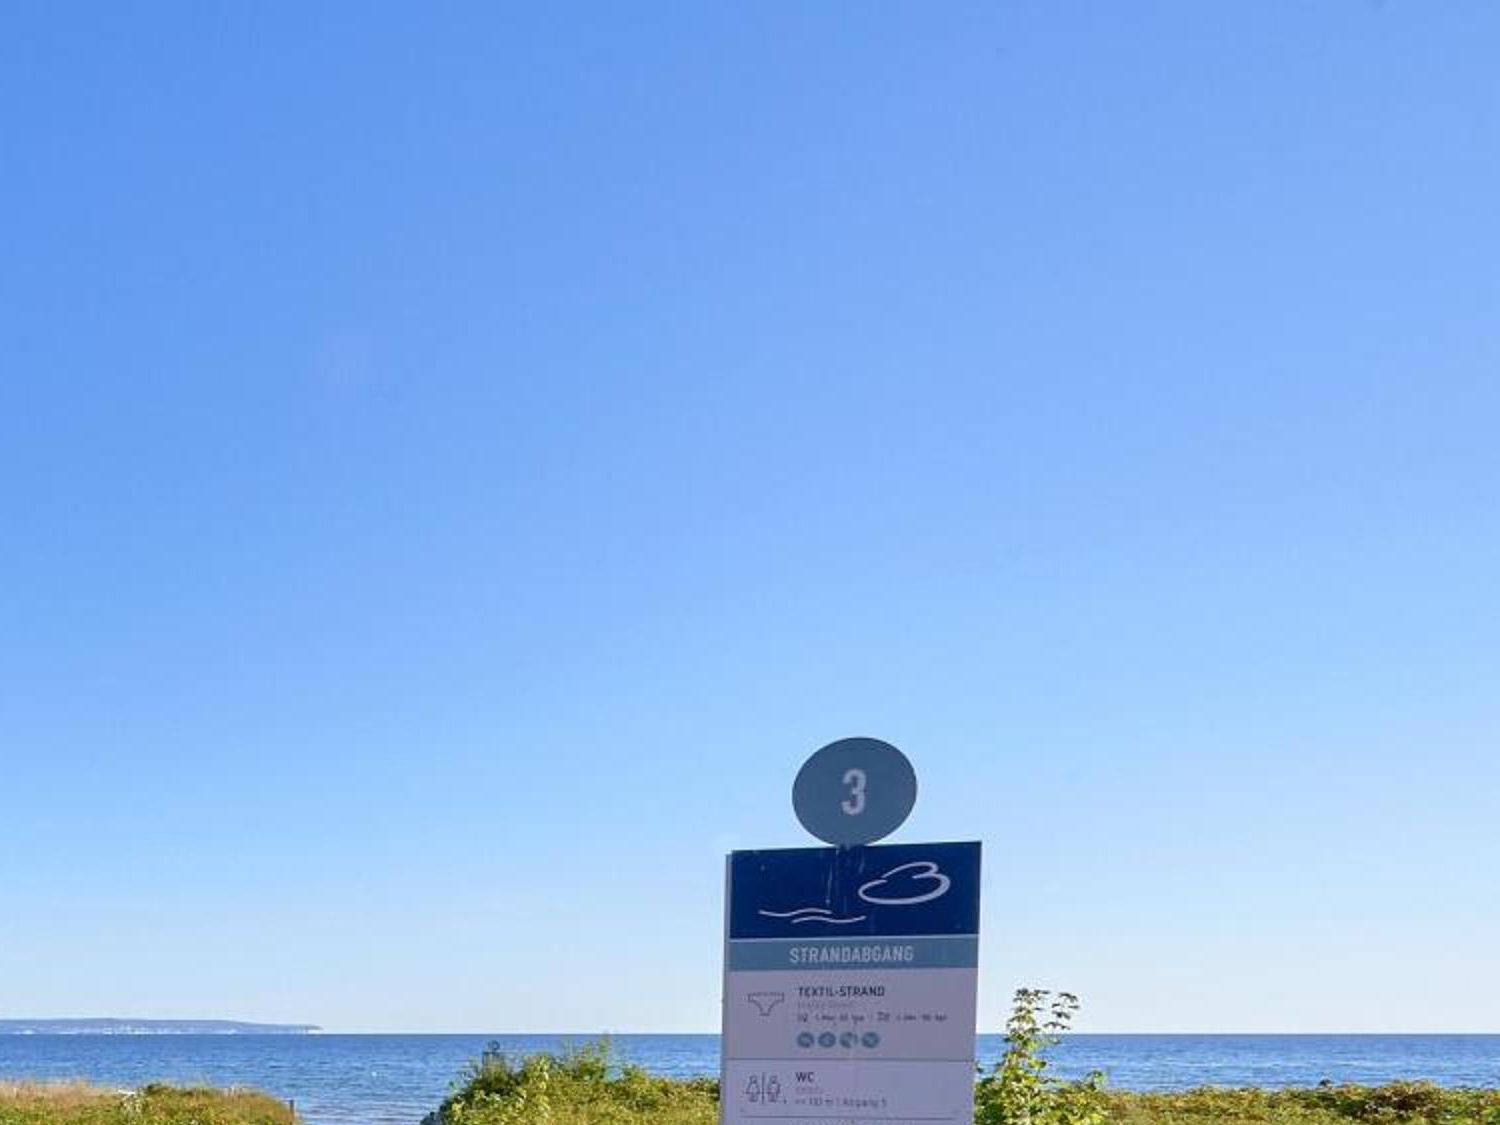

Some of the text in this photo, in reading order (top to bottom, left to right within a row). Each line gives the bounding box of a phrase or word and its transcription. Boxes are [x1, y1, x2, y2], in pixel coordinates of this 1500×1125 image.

[841, 768, 866, 816] 3
[789, 945, 914, 963] STRANDABGANG
[798, 986, 885, 997] TEXTIL-STRAND
[795, 1072, 814, 1082] WC
